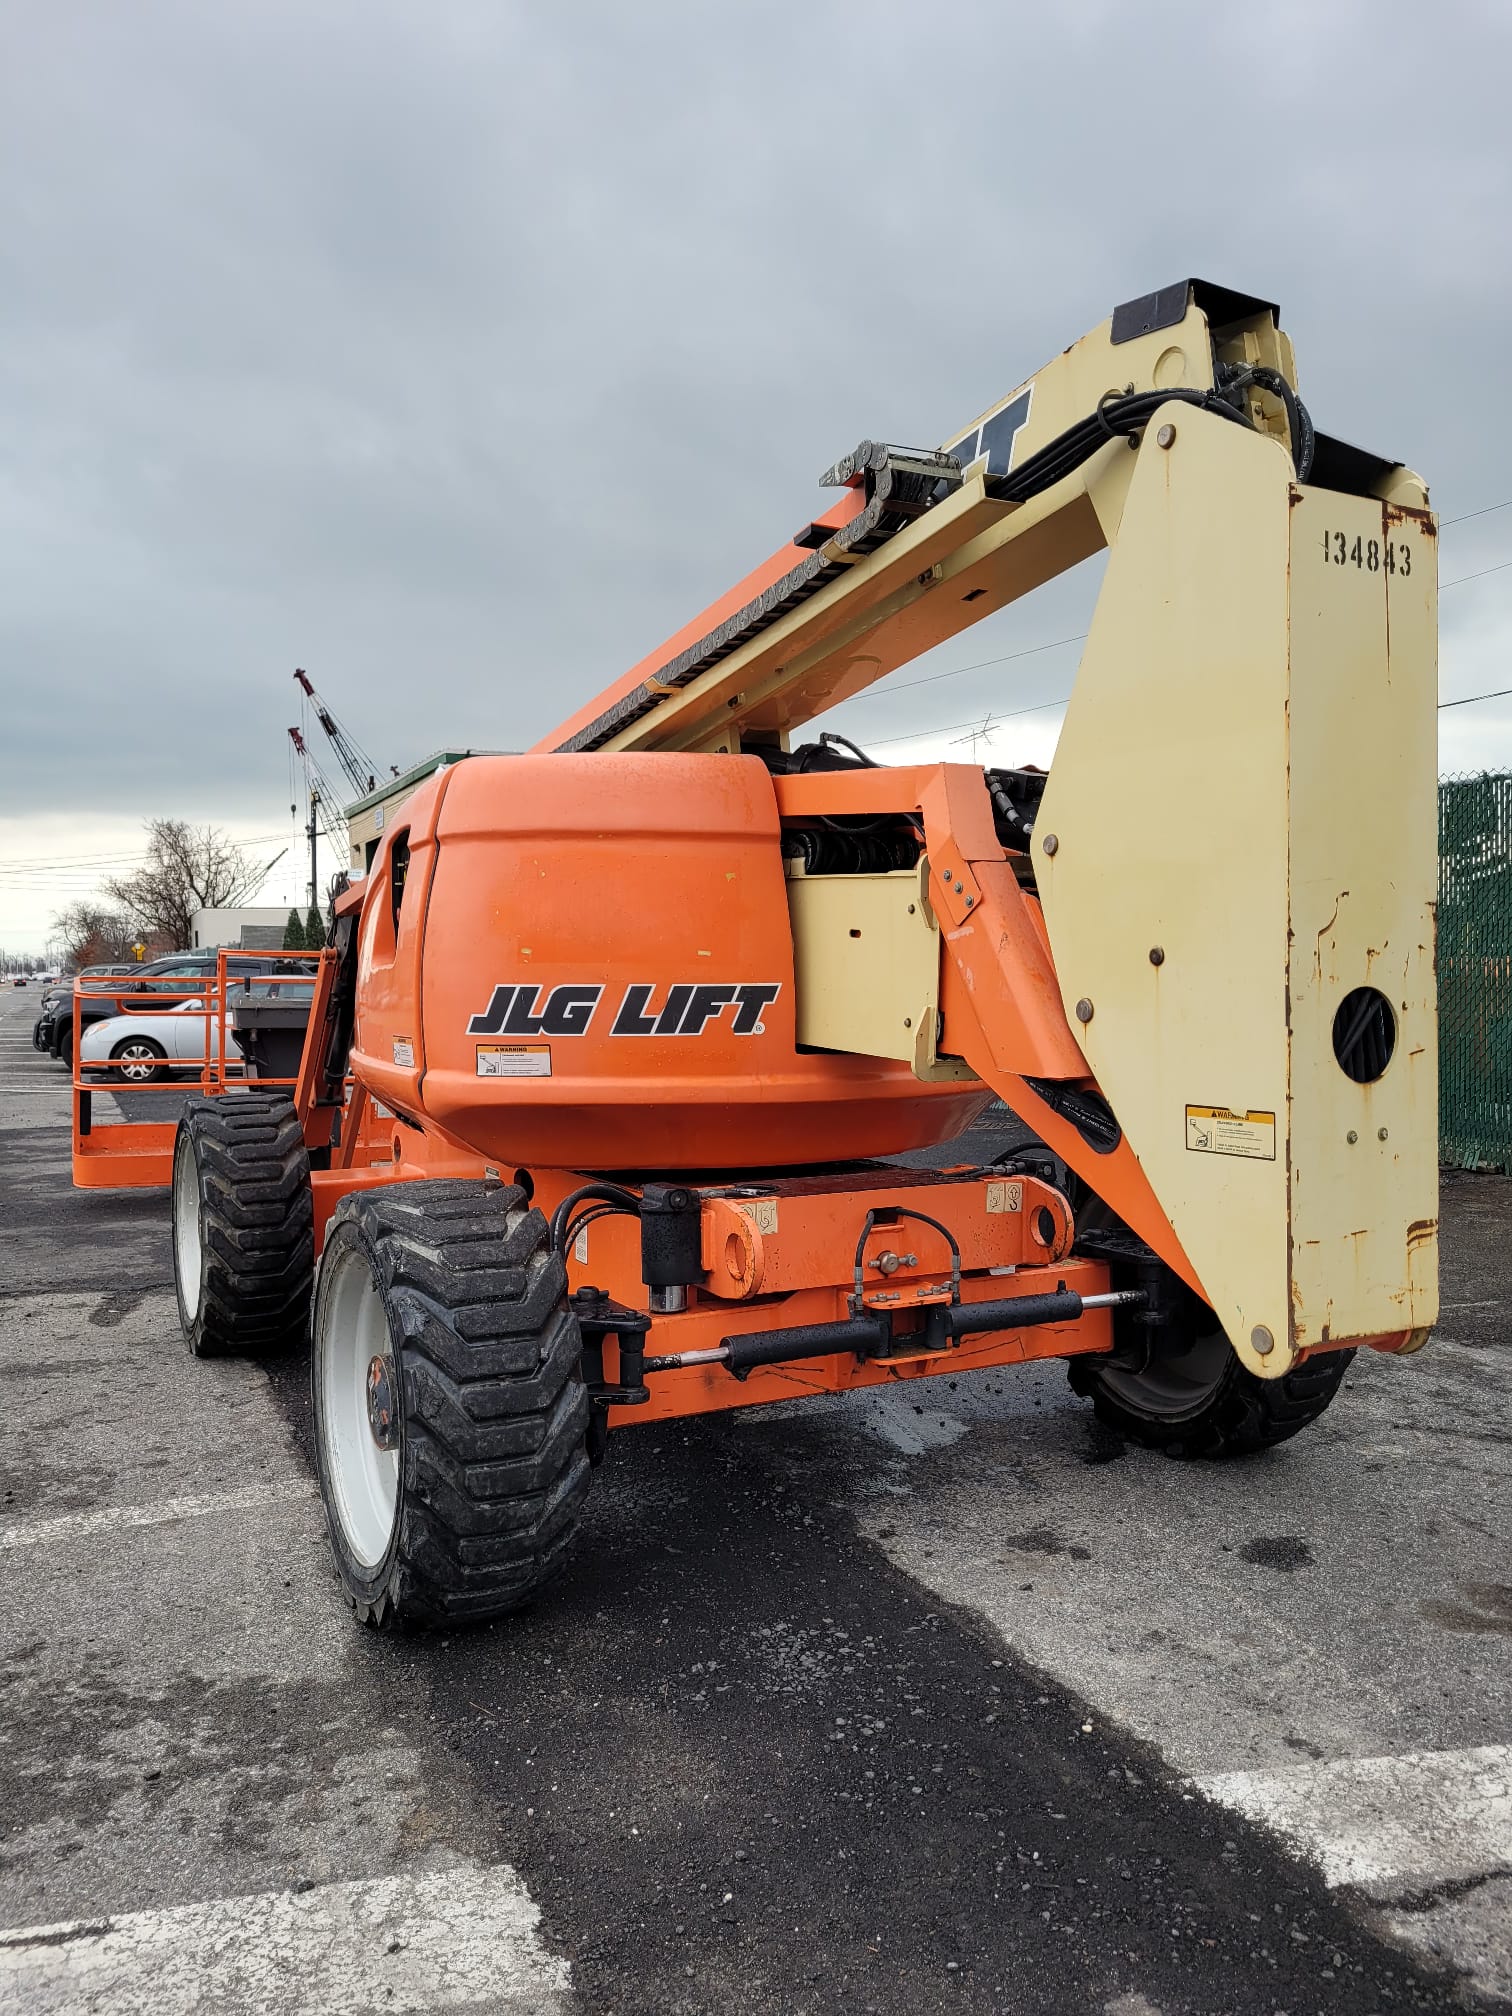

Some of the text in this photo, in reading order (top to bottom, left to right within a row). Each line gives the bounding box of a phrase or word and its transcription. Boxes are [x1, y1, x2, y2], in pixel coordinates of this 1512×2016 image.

[1324, 530, 1412, 577] 134843
[465, 982, 783, 1036] JLG LIFT
[1217, 1110, 1250, 1121] WARG
